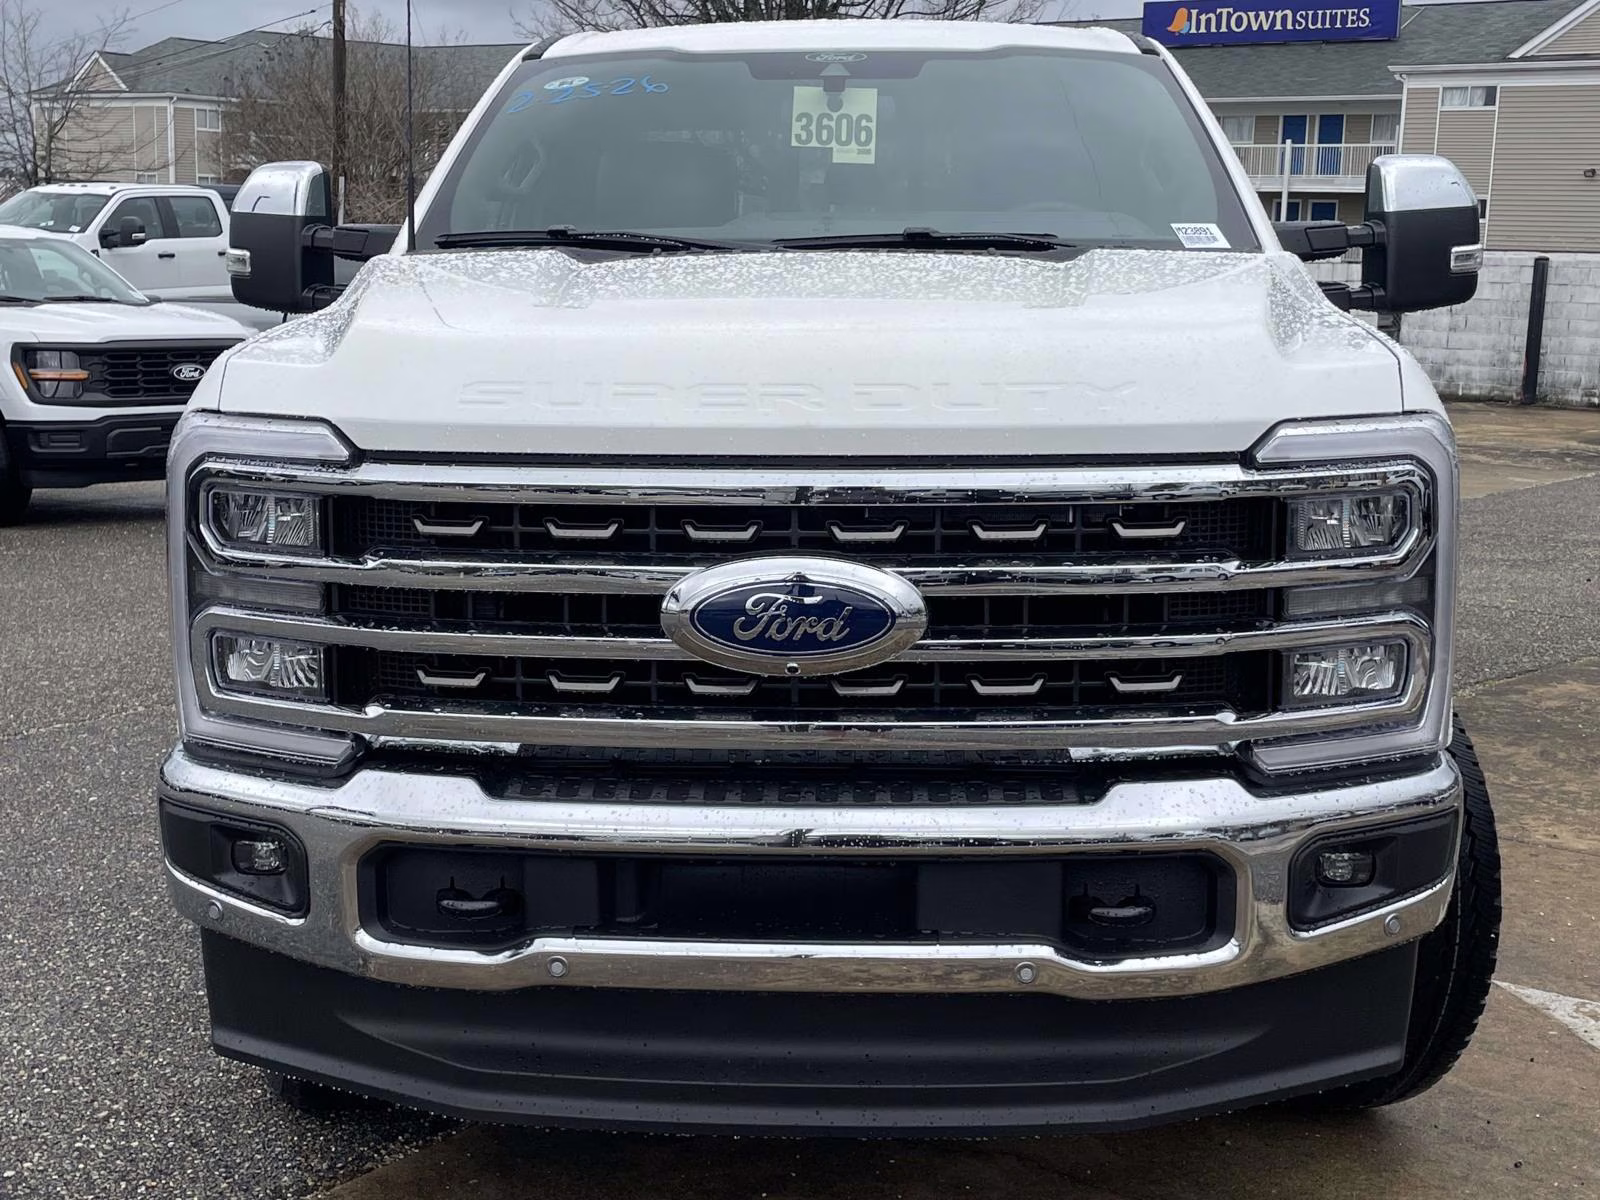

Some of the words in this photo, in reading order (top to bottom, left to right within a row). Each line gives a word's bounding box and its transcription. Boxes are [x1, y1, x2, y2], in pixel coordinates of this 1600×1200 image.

[794, 112, 873, 147] 3606
[180, 367, 201, 377] Ford
[457, 380, 827, 411] SUPER
[853, 380, 1138, 411] DUTY
[733, 592, 852, 641] Ford
